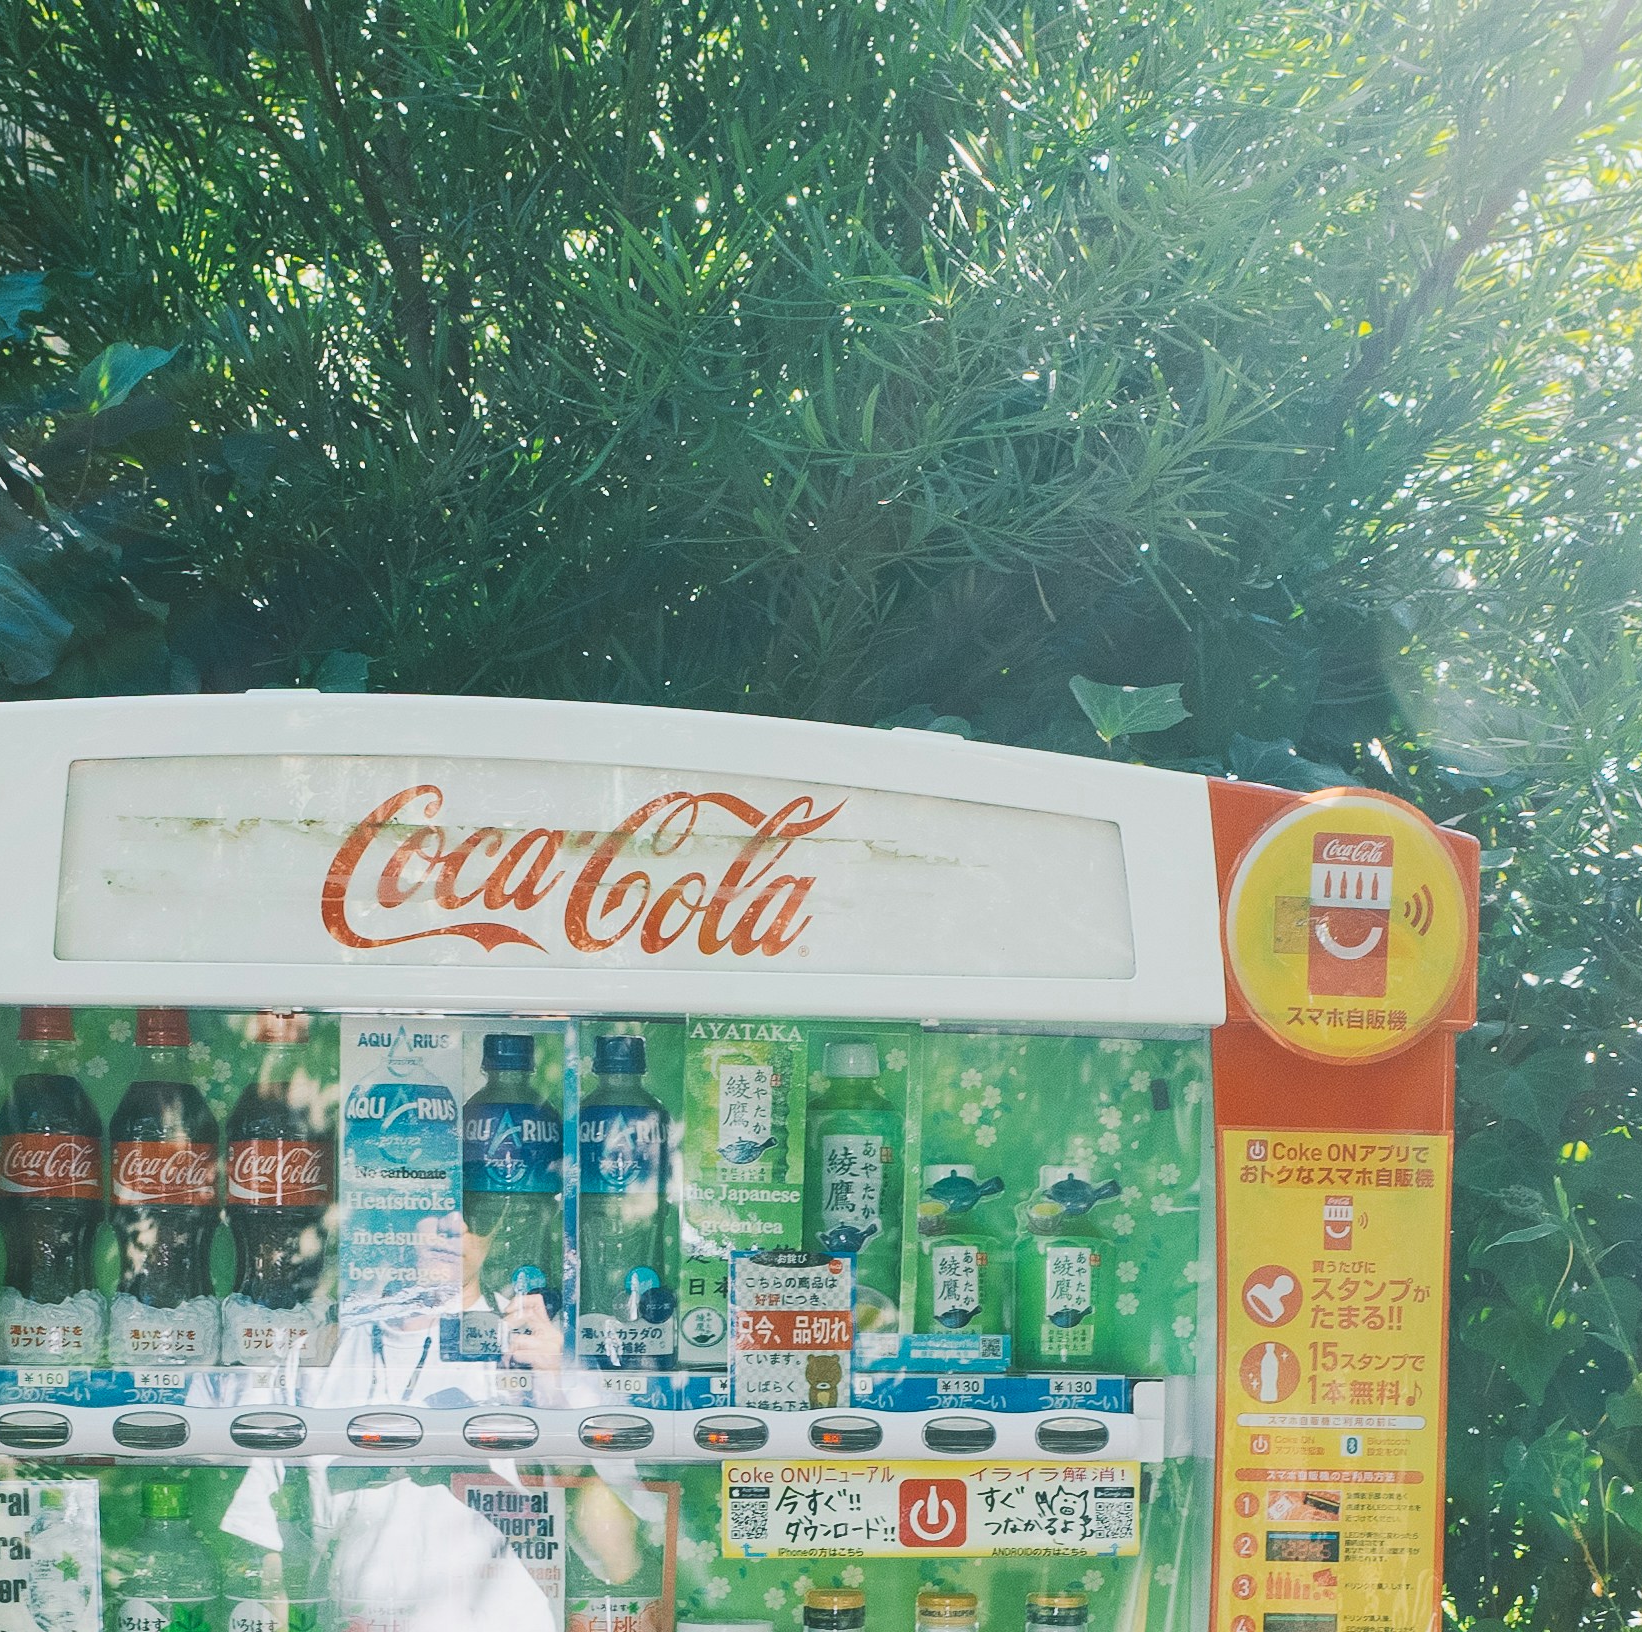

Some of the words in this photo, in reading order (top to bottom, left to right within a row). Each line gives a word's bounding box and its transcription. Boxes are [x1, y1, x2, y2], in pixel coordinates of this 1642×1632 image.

[1322, 839, 1387, 863] Coca-Cola
[320, 784, 849, 957] Coca-Cola
[1286, 1007, 1407, 1031] スマホ自販機
[690, 1023, 804, 1042] AYATAKA
[345, 1091, 456, 1132] AQUARIUS
[724, 1075, 752, 1128] 綾鷹
[752, 1069, 768, 1134] あやたか
[3, 1141, 95, 1178] Coca-Cola
[1273, 1142, 1322, 1161] Coke
[1327, 1144, 1429, 1163] ONアプリで
[119, 1148, 211, 1184] Coca-Cola
[234, 1145, 323, 1183] Coca-Cola
[356, 1167, 378, 1180] No
[381, 1167, 446, 1180] carbonate
[825, 1147, 860, 1212] 綾鷹
[861, 1141, 877, 1219] あやたか
[1240, 1165, 1434, 1188] おトクなスマホ自販機
[346, 1192, 456, 1212] Heatstroke
[719, 1185, 800, 1203] Japanese
[353, 1229, 448, 1246] measures
[777, 1254, 808, 1264] お詫び
[349, 1264, 451, 1284] beverages
[745, 1277, 838, 1289] こちらの商品は
[938, 1256, 961, 1302] 綾鷹
[963, 1250, 975, 1306] あやたか
[1051, 1256, 1075, 1300] 綾鷹
[1076, 1252, 1087, 1306] あやたか
[1311, 1277, 1430, 1303] スタンプが
[1310, 1305, 1403, 1330] たまる!!
[736, 1316, 849, 1344] 只今、品切れ
[743, 1354, 802, 1366] ています。
[1309, 1342, 1425, 1371] 15スタンプで
[23, 1372, 65, 1386] ¥160
[603, 1378, 642, 1392] ¥160
[746, 1381, 794, 1393] しばらく
[941, 1380, 980, 1392] ¥130
[1054, 1380, 1093, 1393] ¥130
[727, 1468, 774, 1483] Coke
[781, 1467, 895, 1484] ONリニューアル
[968, 1467, 1126, 1483] イライラ解消!
[467, 1490, 548, 1512] Natural
[977, 1487, 1024, 1513] すぐ
[1242, 1497, 1251, 1514] 1
[985, 1517, 1080, 1540] つながるよ
[1241, 1537, 1251, 1552] 2
[1238, 1579, 1250, 1594] 3
[118, 1618, 166, 1632] いろはす
[232, 1619, 278, 1632] いろはす
